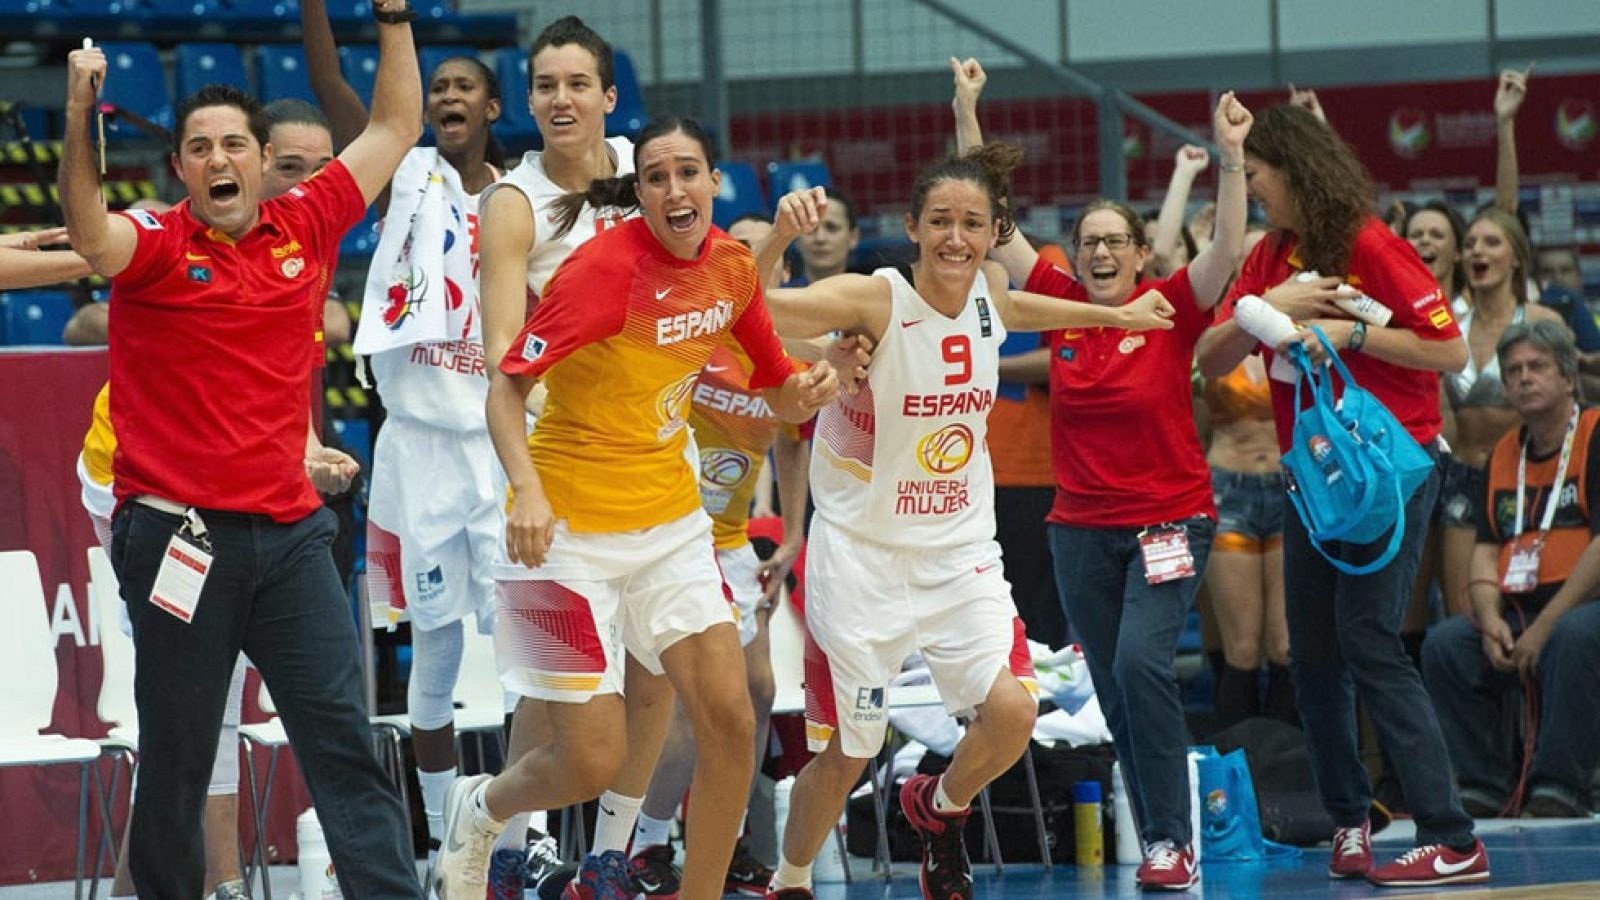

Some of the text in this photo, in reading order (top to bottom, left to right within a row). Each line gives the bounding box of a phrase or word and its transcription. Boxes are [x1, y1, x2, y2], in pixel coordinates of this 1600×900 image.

[410, 346, 487, 377] MUJER
[941, 334, 972, 386] 9
[902, 386, 992, 417] ESPAÑA
[895, 489, 970, 515] MUJER
